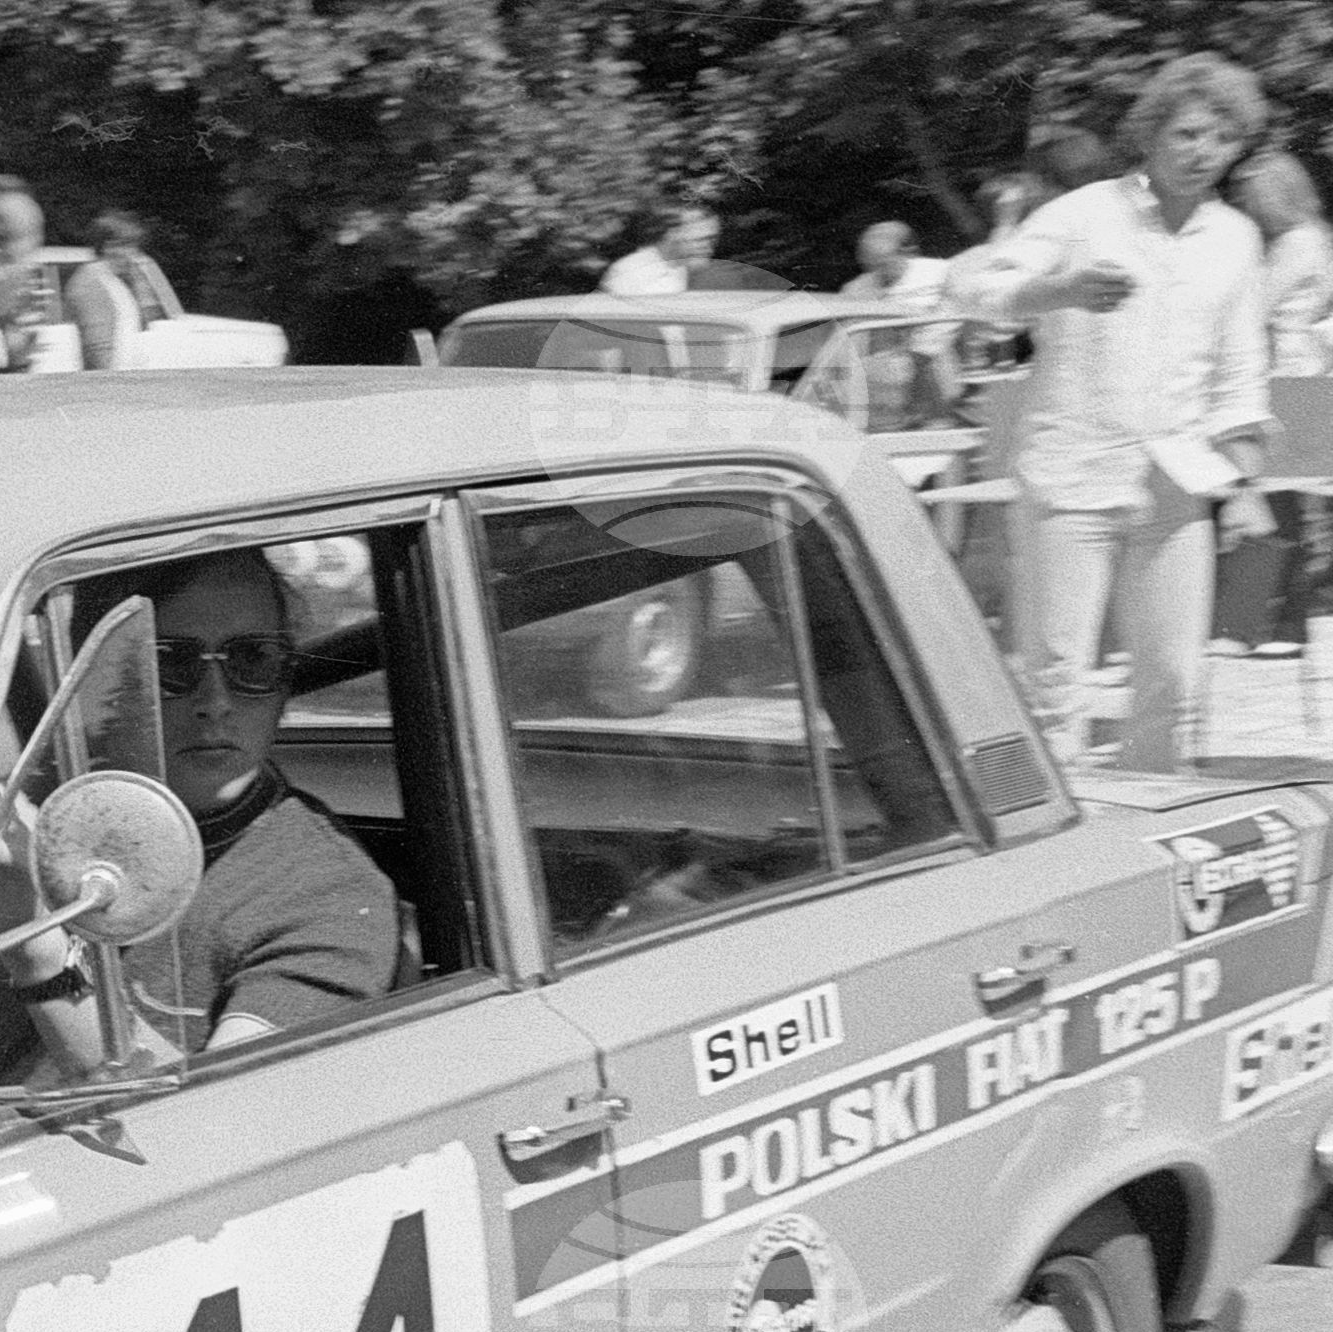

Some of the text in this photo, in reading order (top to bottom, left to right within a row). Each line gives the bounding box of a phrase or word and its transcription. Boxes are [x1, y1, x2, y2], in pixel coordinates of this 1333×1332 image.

[706, 993, 832, 1083] Shell
[699, 1063, 937, 1221] POLSKI
[966, 1008, 1070, 1110] FIAT
